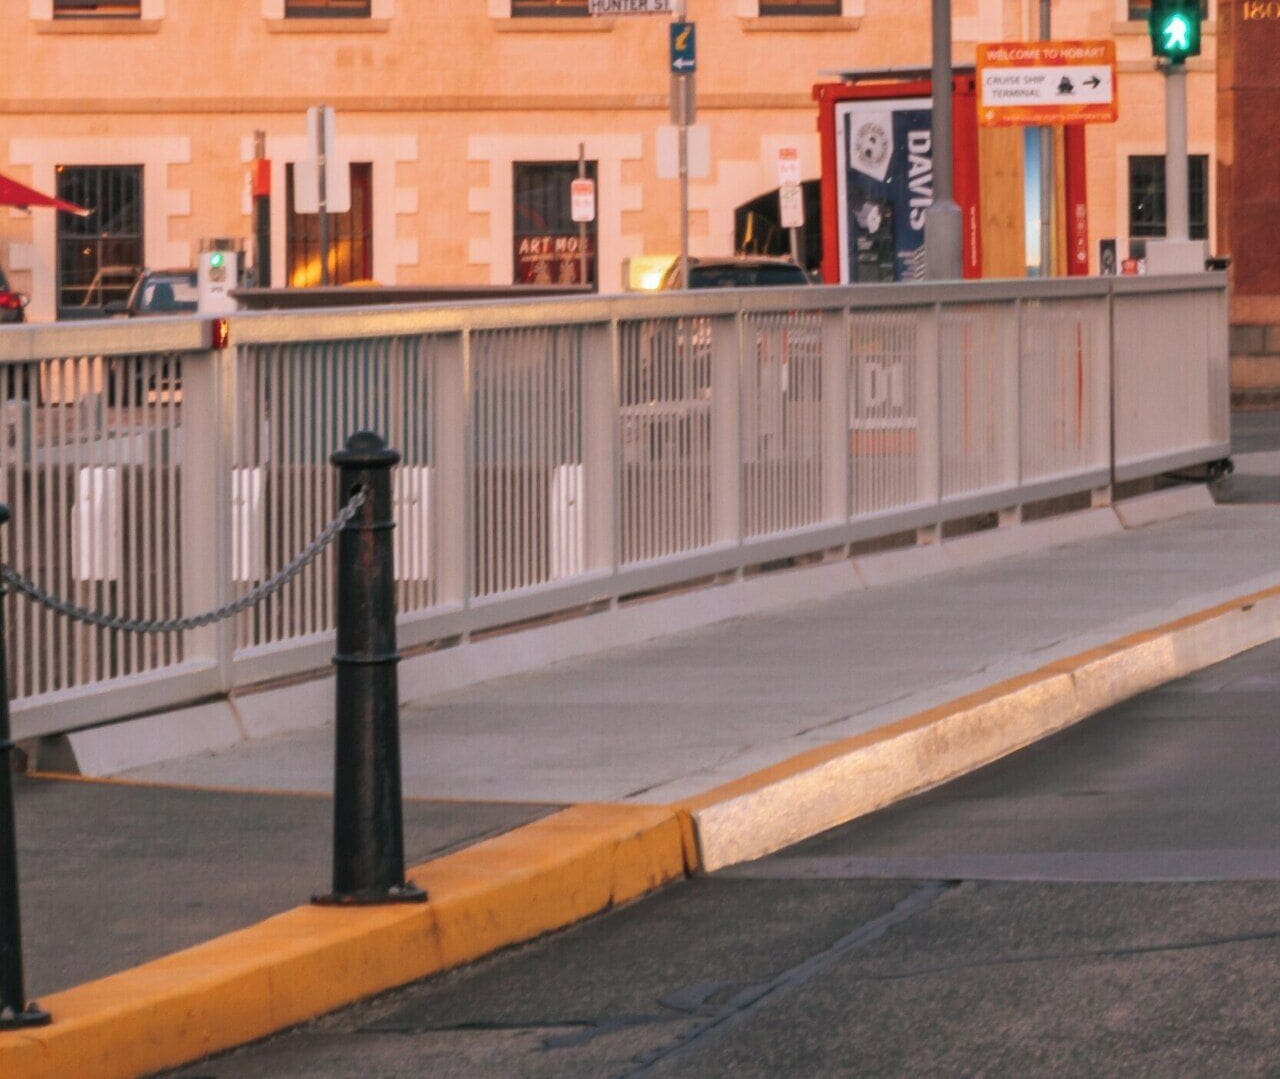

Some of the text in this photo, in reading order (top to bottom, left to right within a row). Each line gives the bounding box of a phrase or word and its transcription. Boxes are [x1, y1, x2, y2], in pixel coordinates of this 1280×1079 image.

[986, 47, 1106, 61] WELCOME TO HOBART
[986, 76, 1021, 85] CRUISE
[992, 89, 1040, 98] TERMINAL
[907, 130, 934, 231] DAVIS
[519, 236, 589, 255] ART MO
